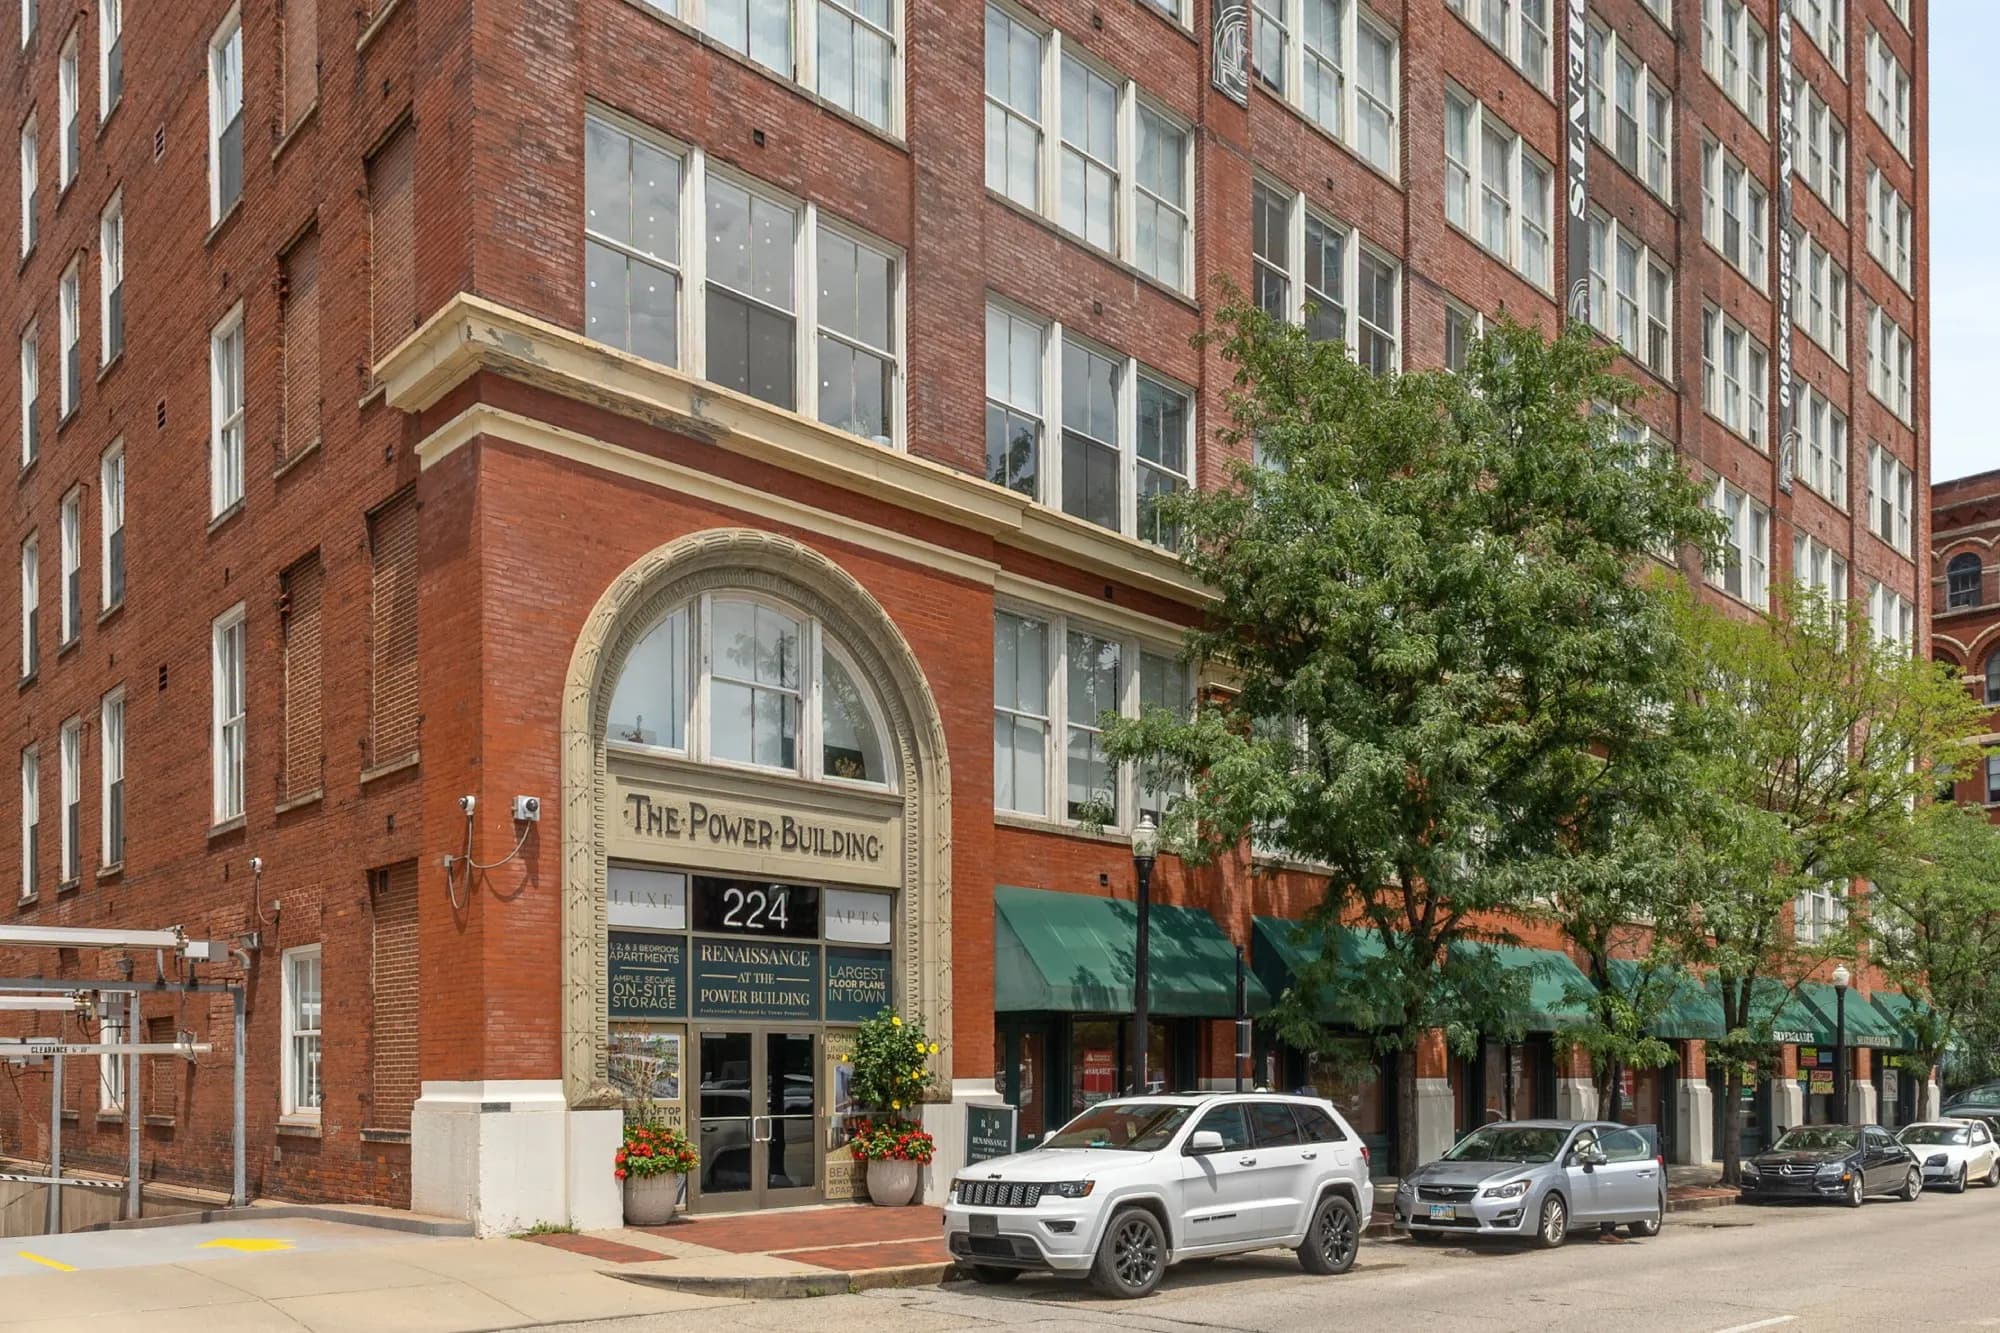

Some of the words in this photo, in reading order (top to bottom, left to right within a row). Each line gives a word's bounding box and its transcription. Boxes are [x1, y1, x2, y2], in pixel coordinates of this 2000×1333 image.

[1778, 12, 1792, 189] OPEN
[626, 793, 681, 838] THE
[688, 801, 772, 849] POWER
[780, 815, 880, 862] BUILDING
[613, 889, 673, 910] LUXE
[723, 888, 789, 930] 224
[833, 908, 880, 927] APTS
[639, 944, 679, 954] BEDROOM
[701, 944, 811, 967] RENAISSANCE
[609, 951, 680, 964] APARTMENTS
[737, 971, 752, 984] AT
[753, 972, 775, 984] THE
[829, 965, 886, 981] LARGEST
[644, 976, 677, 985] SECURE
[829, 979, 857, 989] FLOOR
[859, 980, 886, 990] PLANS
[613, 982, 677, 998] ON-SITE
[829, 988, 843, 1002] IN
[846, 990, 886, 1003] TOWN
[613, 996, 677, 1009] STORAGE
[701, 989, 748, 1004] POWER
[751, 991, 810, 1006] BUILDING
[827, 1032, 857, 1043] CONN
[31, 1046, 67, 1054] CLEARANCE
[669, 1116, 680, 1125] IN
[972, 1136, 1009, 1148] RENAISSANCE
